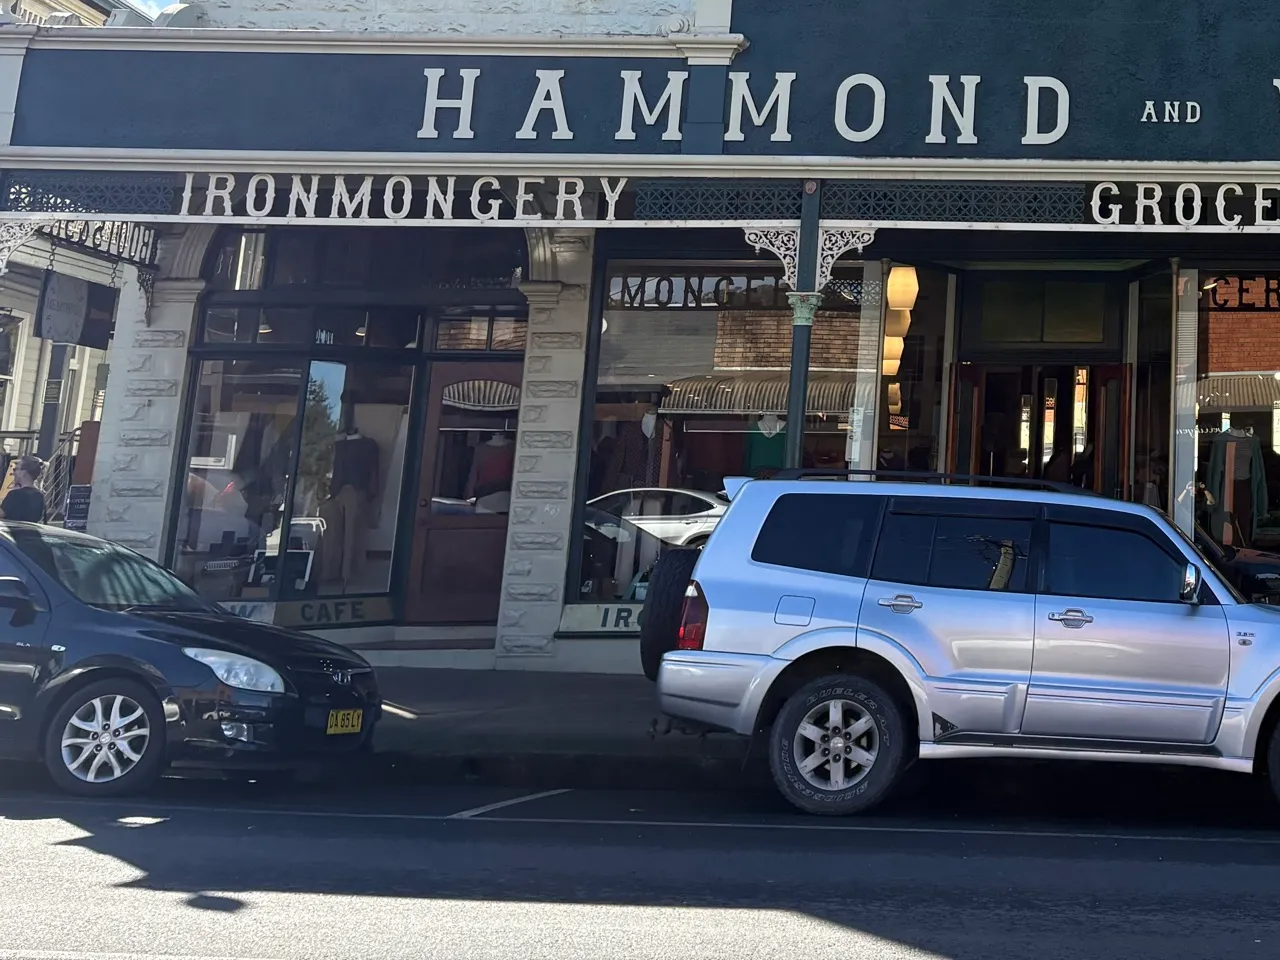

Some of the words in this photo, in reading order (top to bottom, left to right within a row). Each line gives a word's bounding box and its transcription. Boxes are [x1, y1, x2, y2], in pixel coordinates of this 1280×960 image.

[416, 68, 1070, 146] HAMMOND
[1140, 100, 1201, 123] AND
[179, 172, 629, 220] IRONMONGERY
[300, 601, 364, 622] CAFE
